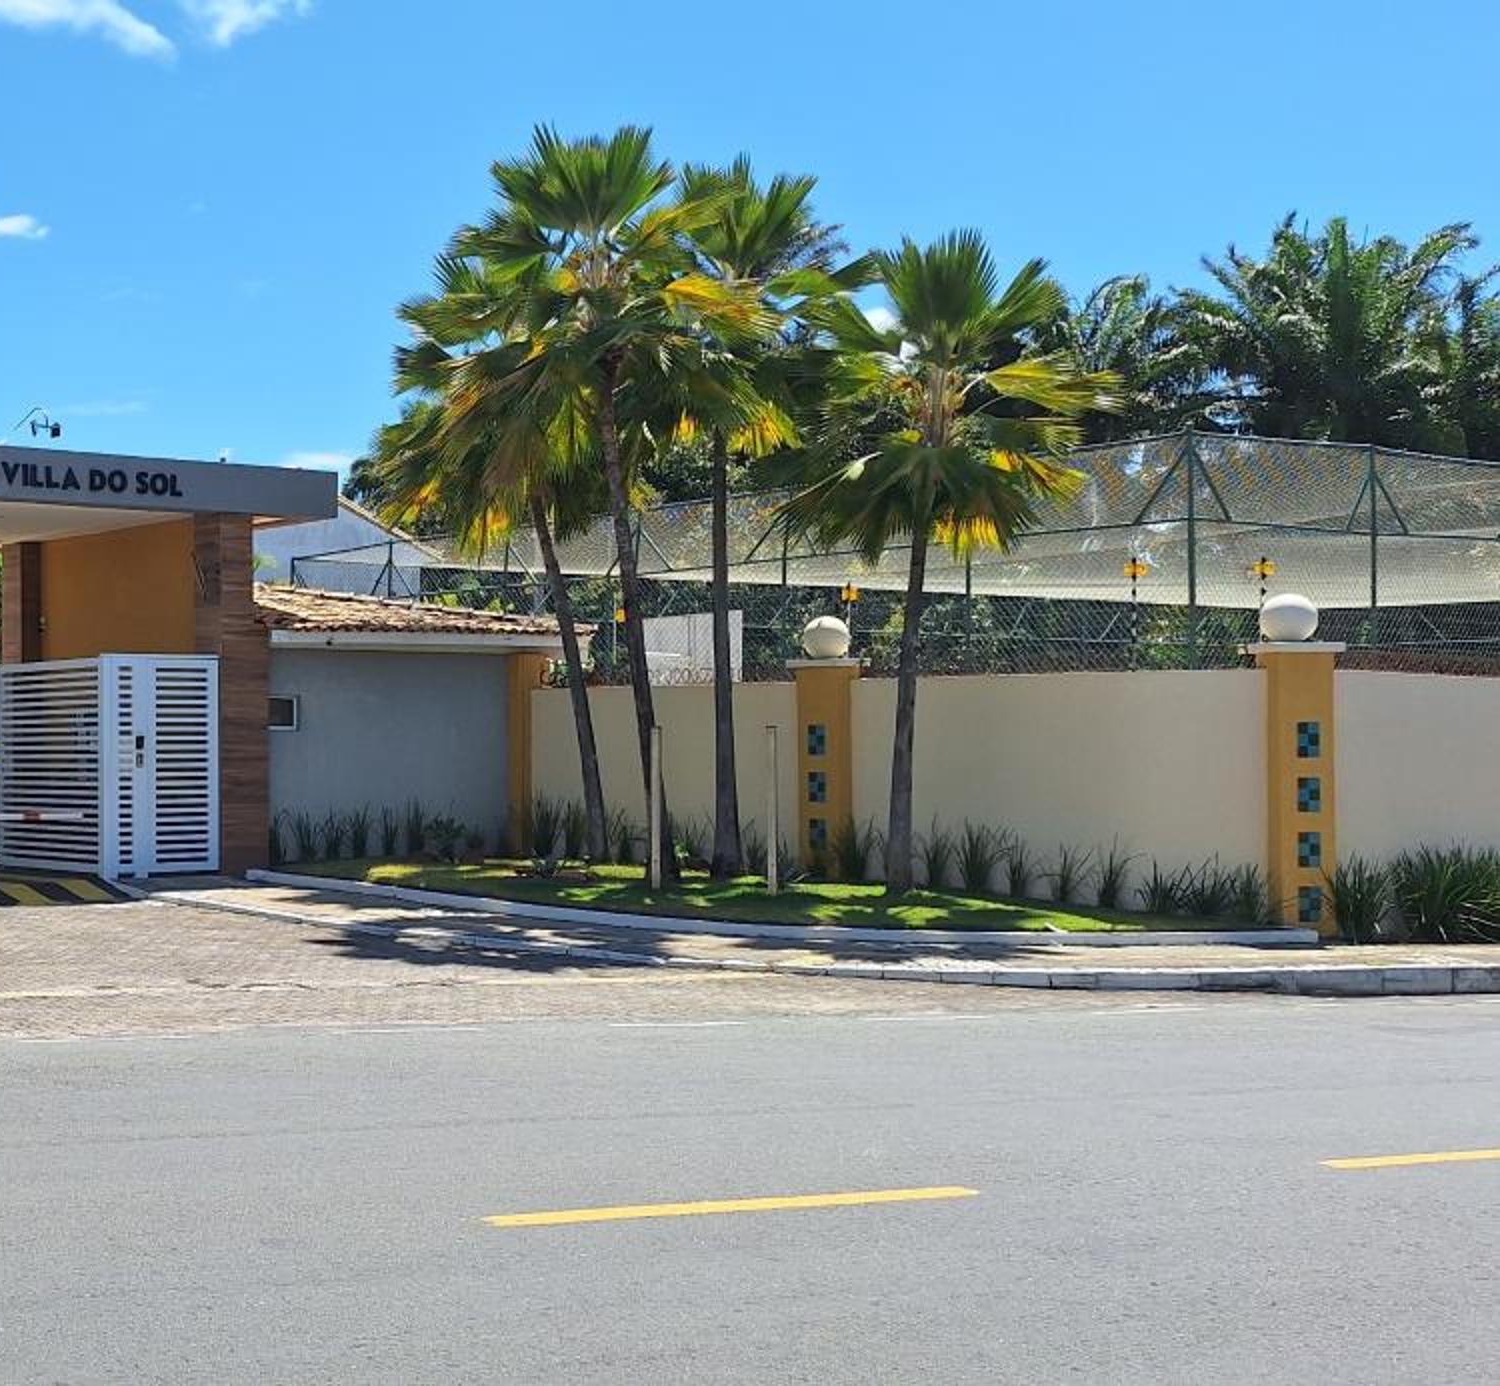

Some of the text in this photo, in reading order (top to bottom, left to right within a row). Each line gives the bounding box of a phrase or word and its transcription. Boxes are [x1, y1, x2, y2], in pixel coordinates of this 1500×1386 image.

[1, 461, 81, 491] VILLA
[89, 469, 129, 493] DO
[135, 471, 184, 497] SOL
